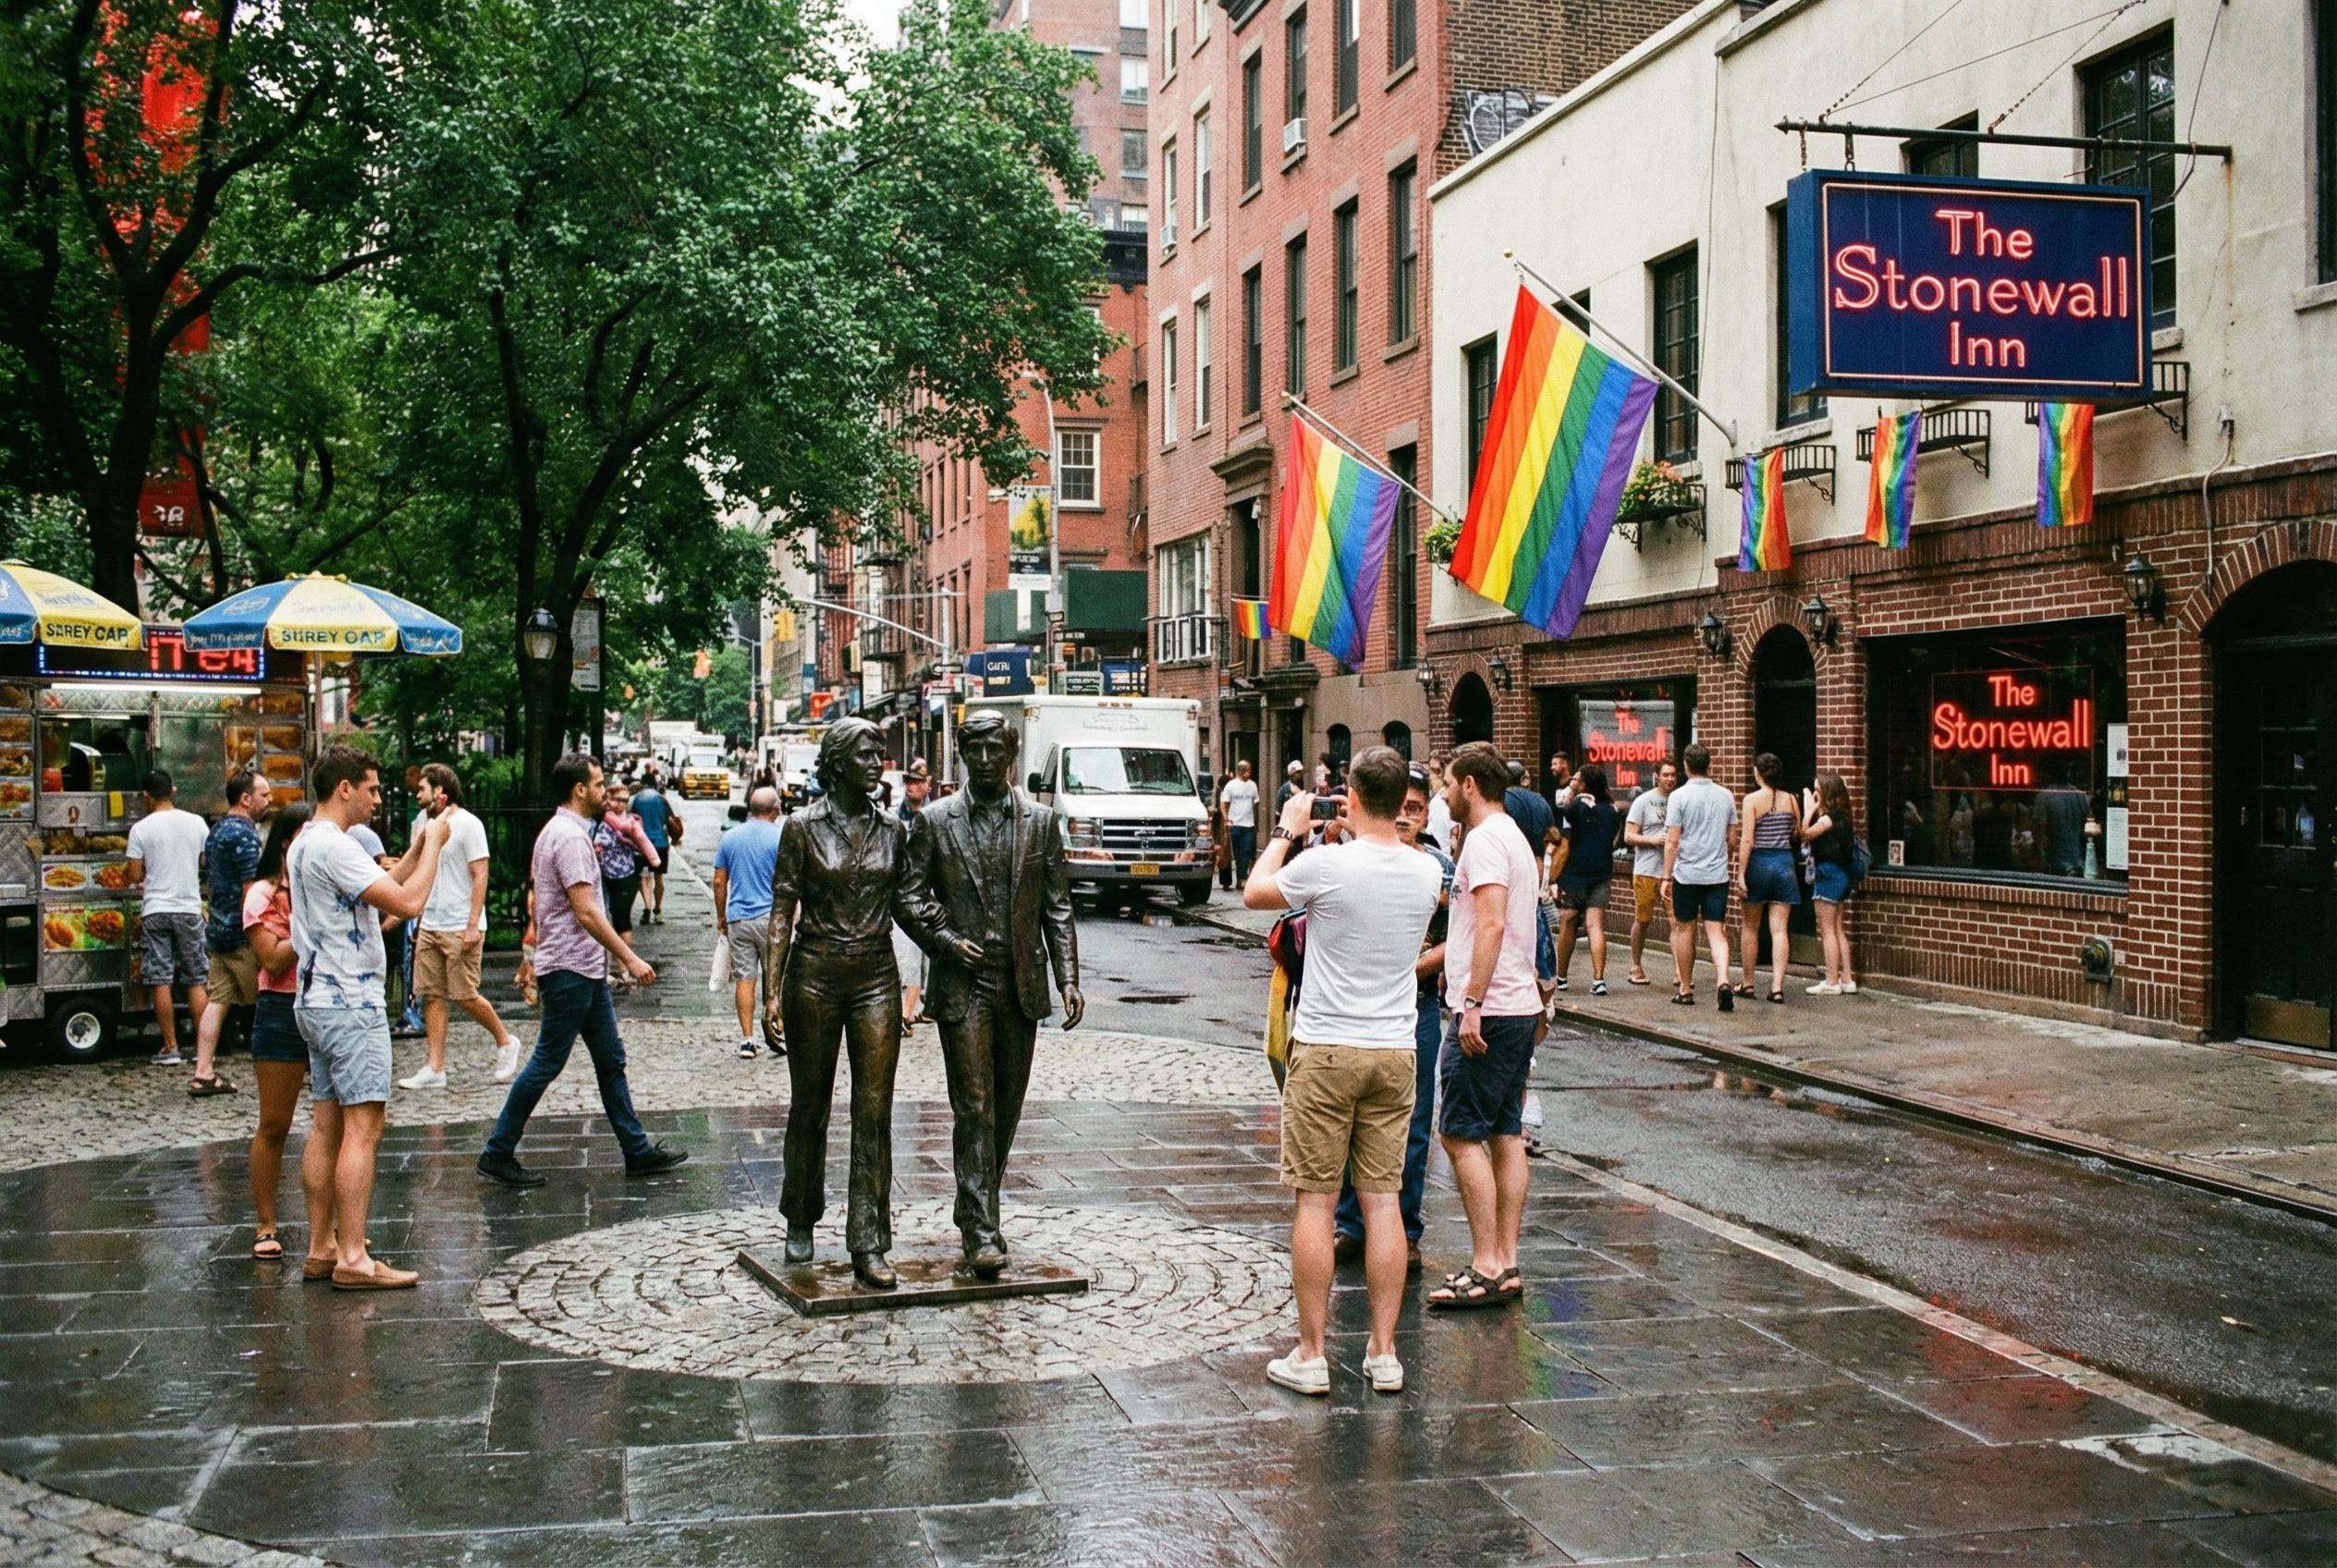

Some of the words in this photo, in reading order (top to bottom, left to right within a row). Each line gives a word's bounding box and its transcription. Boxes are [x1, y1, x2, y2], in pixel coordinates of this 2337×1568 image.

[1936, 209, 2033, 260] The
[1834, 245, 2127, 319] Stonewall
[1951, 321, 2025, 368] Inn
[1988, 675, 2036, 707] The
[1933, 698, 2090, 750] Stonewall
[1616, 764, 1638, 787] Inn
[1990, 753, 2030, 785] Inn
